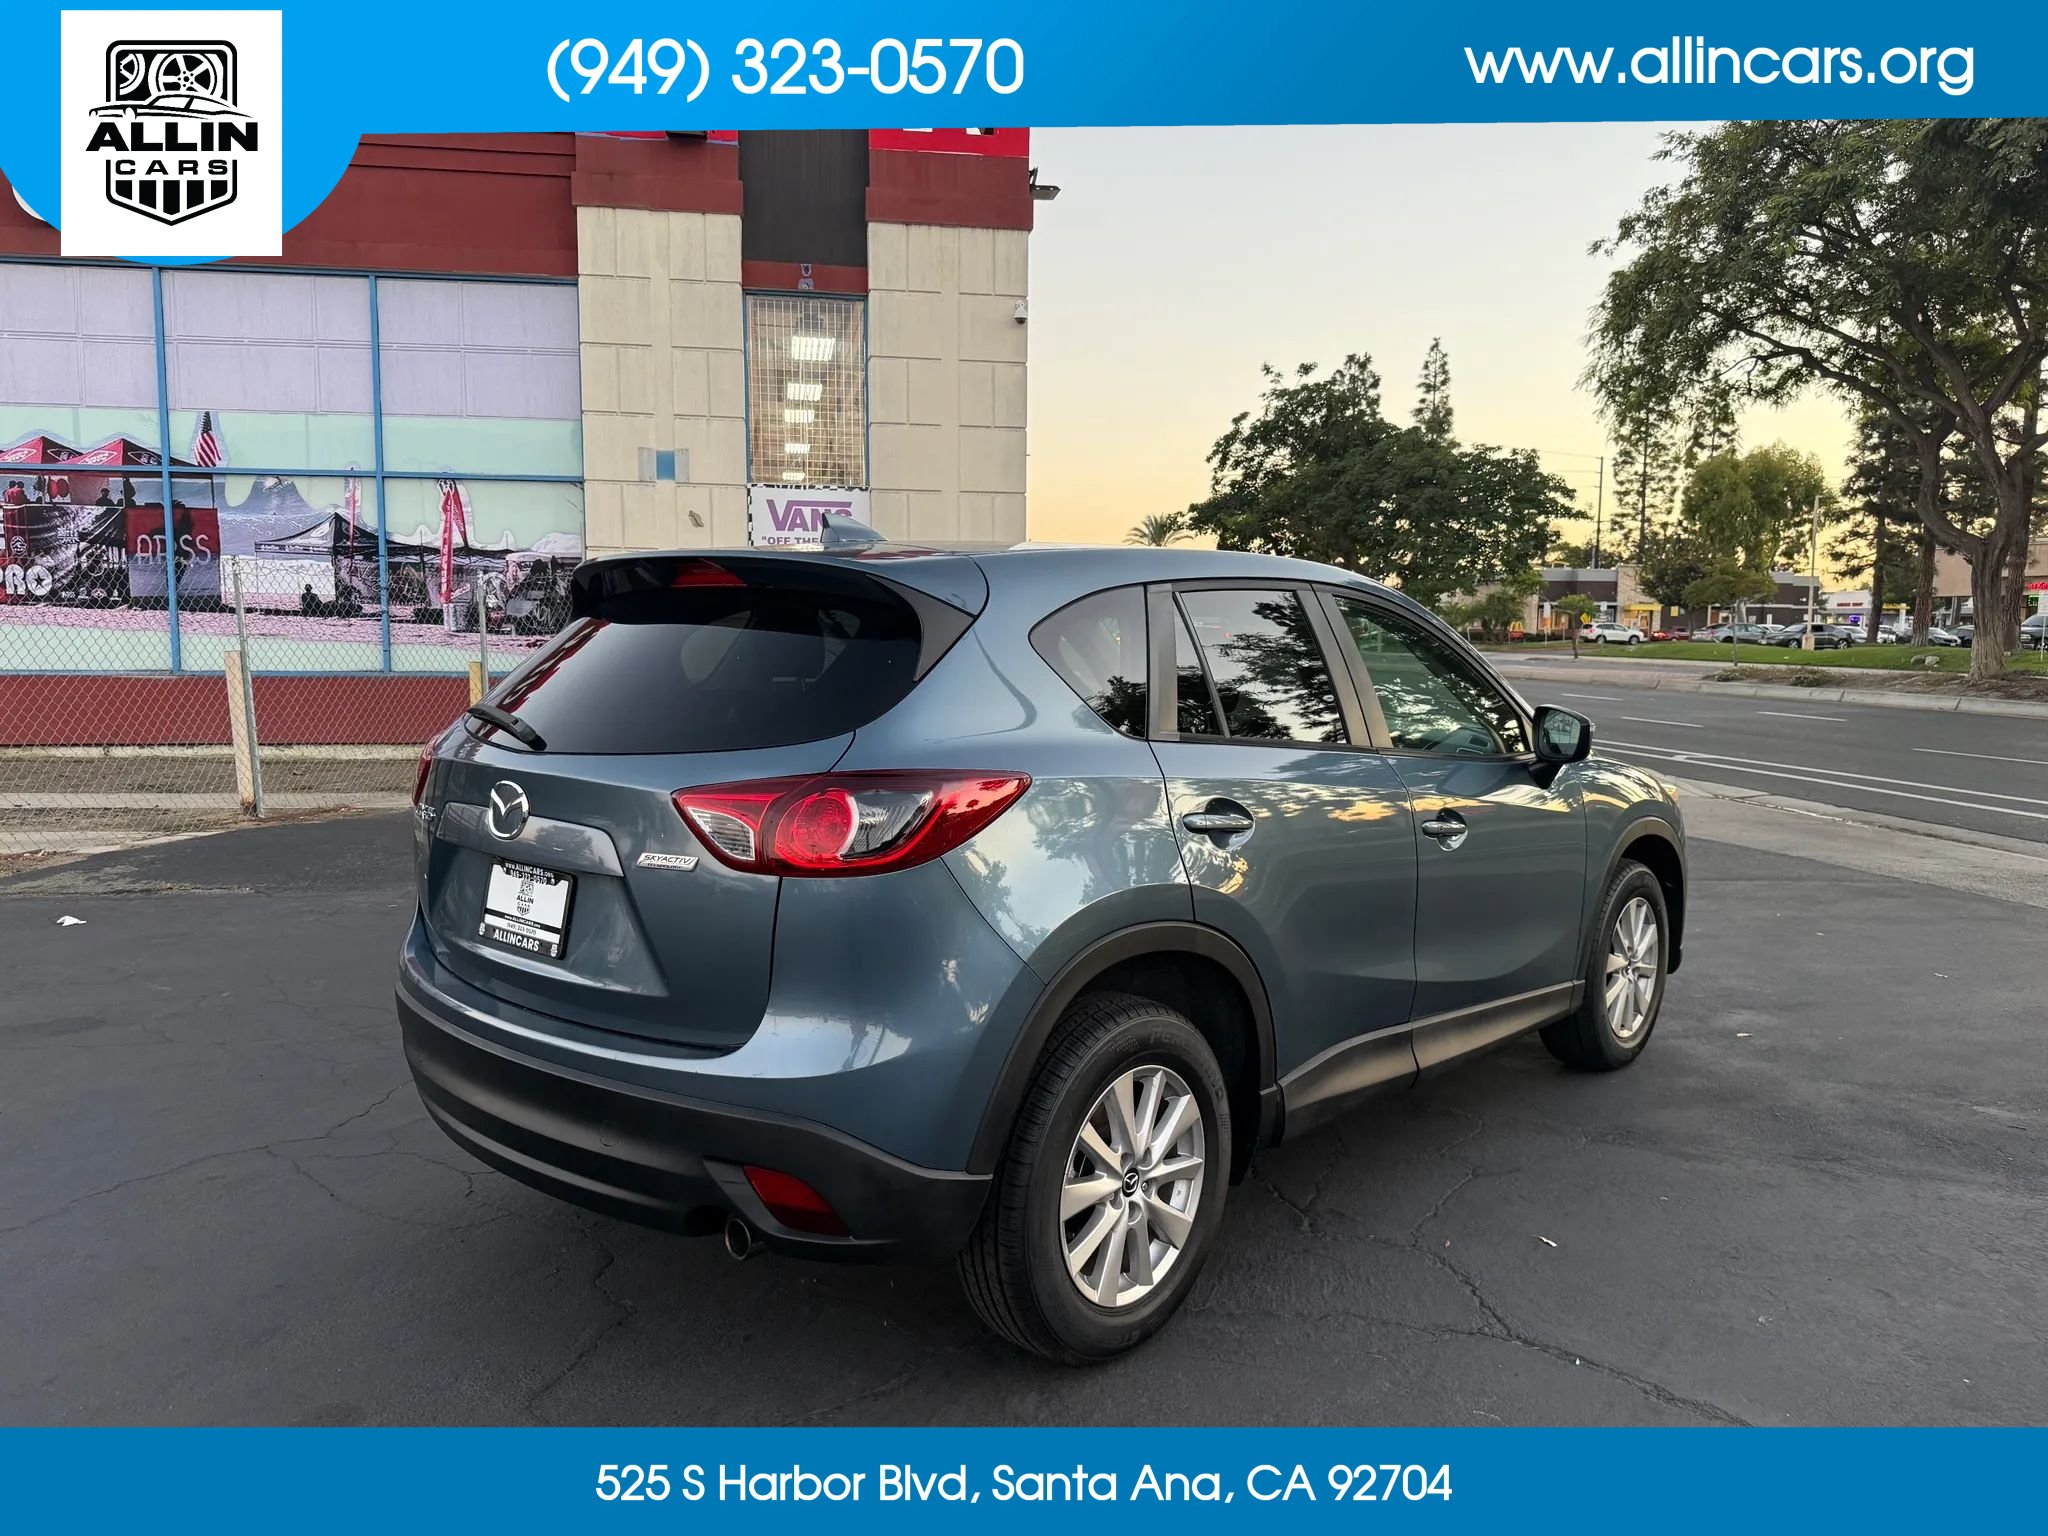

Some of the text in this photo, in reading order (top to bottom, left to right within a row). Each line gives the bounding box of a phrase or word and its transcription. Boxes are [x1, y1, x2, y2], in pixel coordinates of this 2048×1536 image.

[0, 564, 52, 596] RO
[644, 854, 692, 864] SKYACTIV
[516, 894, 535, 905] ALLIN
[493, 928, 540, 952] ALLINCARS
